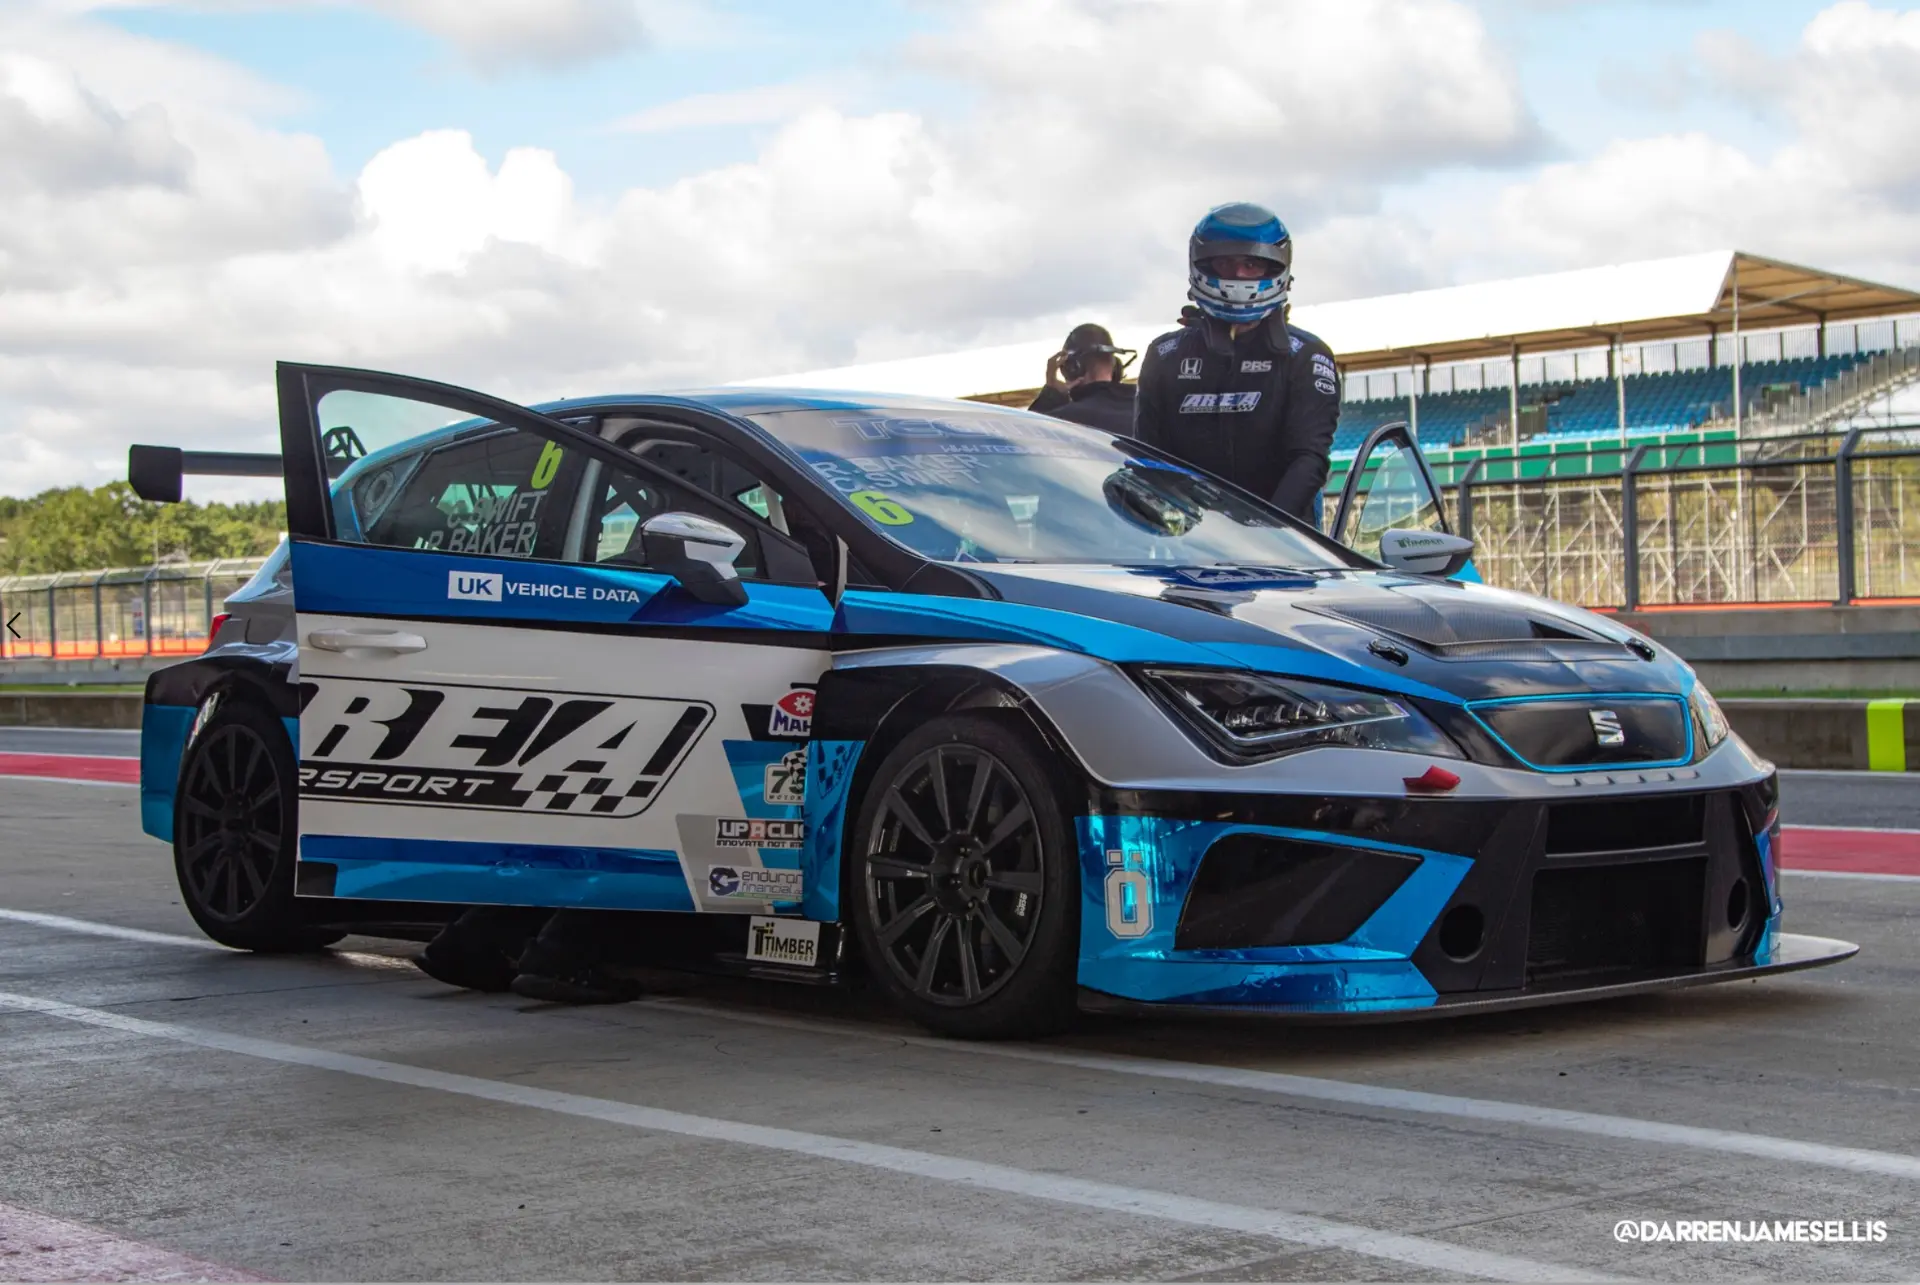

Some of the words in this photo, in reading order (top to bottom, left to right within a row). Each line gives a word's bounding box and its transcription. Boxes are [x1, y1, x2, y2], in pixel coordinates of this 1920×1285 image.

[849, 490, 914, 526] 6
[449, 521, 537, 554] BAKER
[457, 577, 493, 596] UK
[505, 581, 587, 600] VEHICLE
[592, 587, 640, 603] DATA
[765, 936, 814, 956] TIMBER
